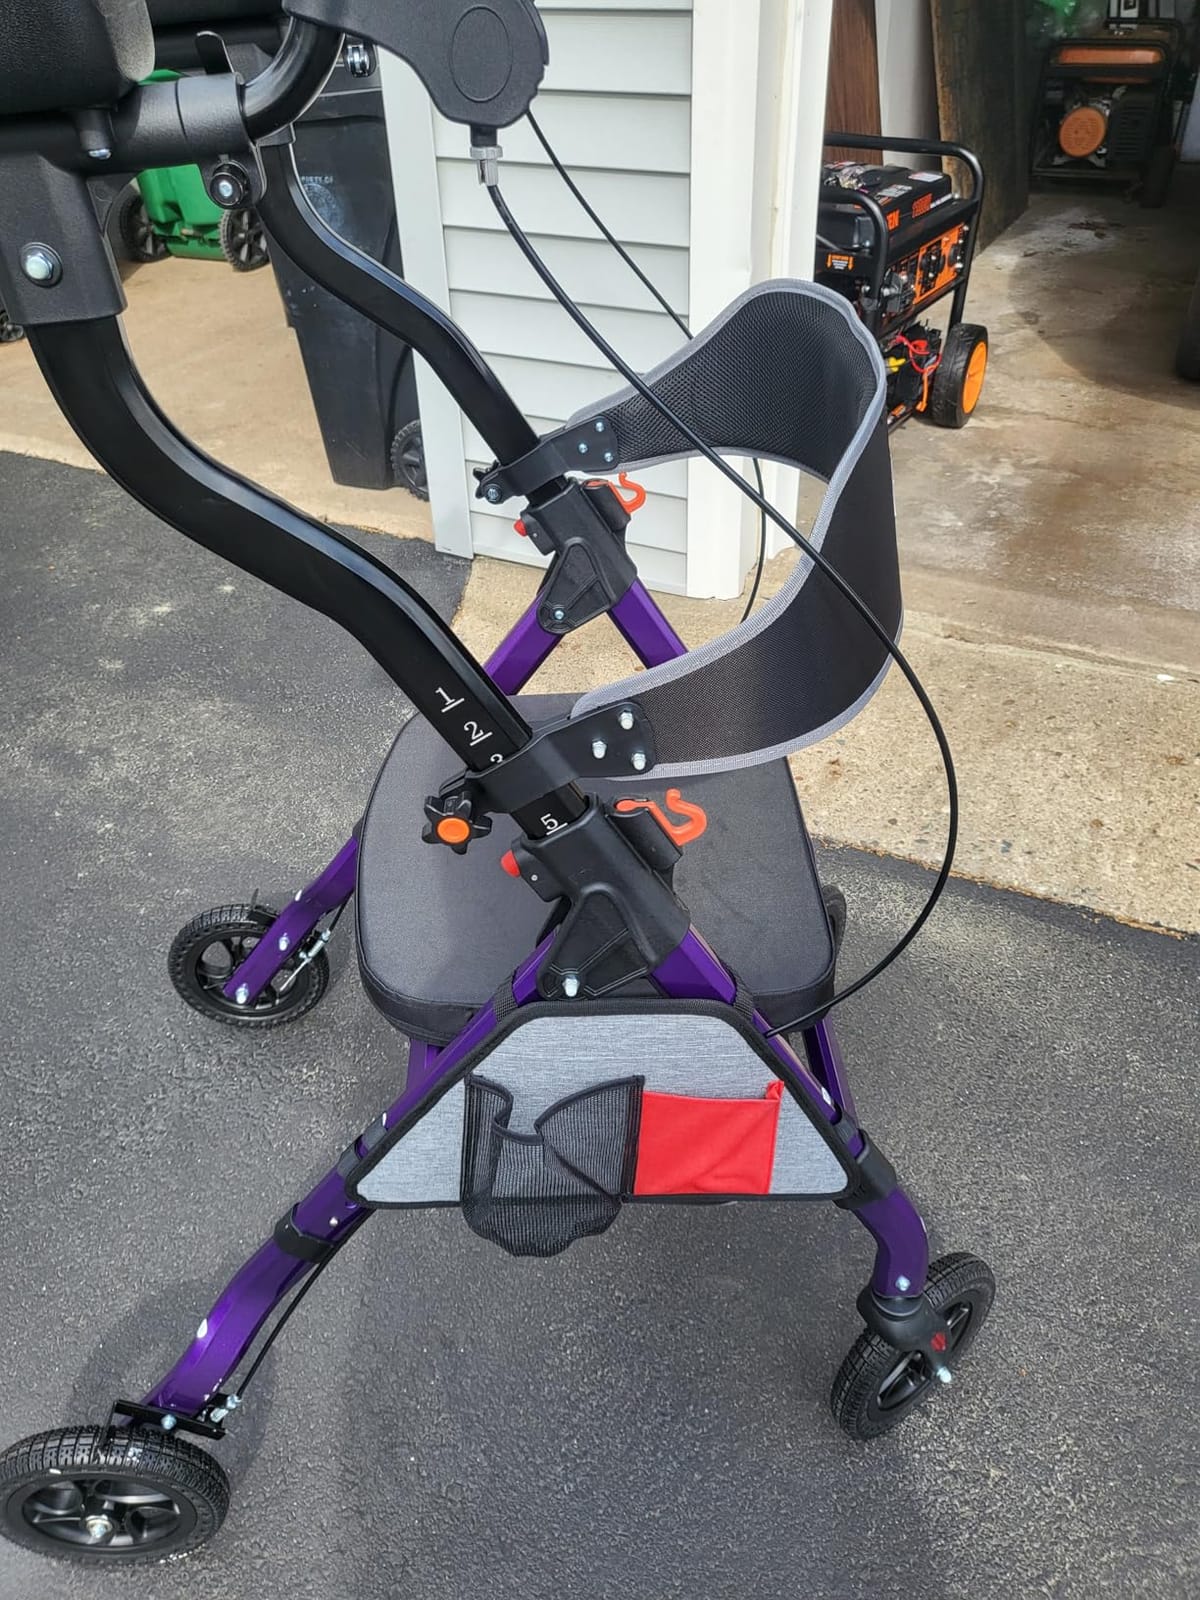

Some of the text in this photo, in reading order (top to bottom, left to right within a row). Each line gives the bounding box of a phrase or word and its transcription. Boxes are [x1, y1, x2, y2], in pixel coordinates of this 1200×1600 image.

[435, 687, 457, 706] 1
[463, 721, 484, 740] 2
[540, 813, 559, 831] 5
